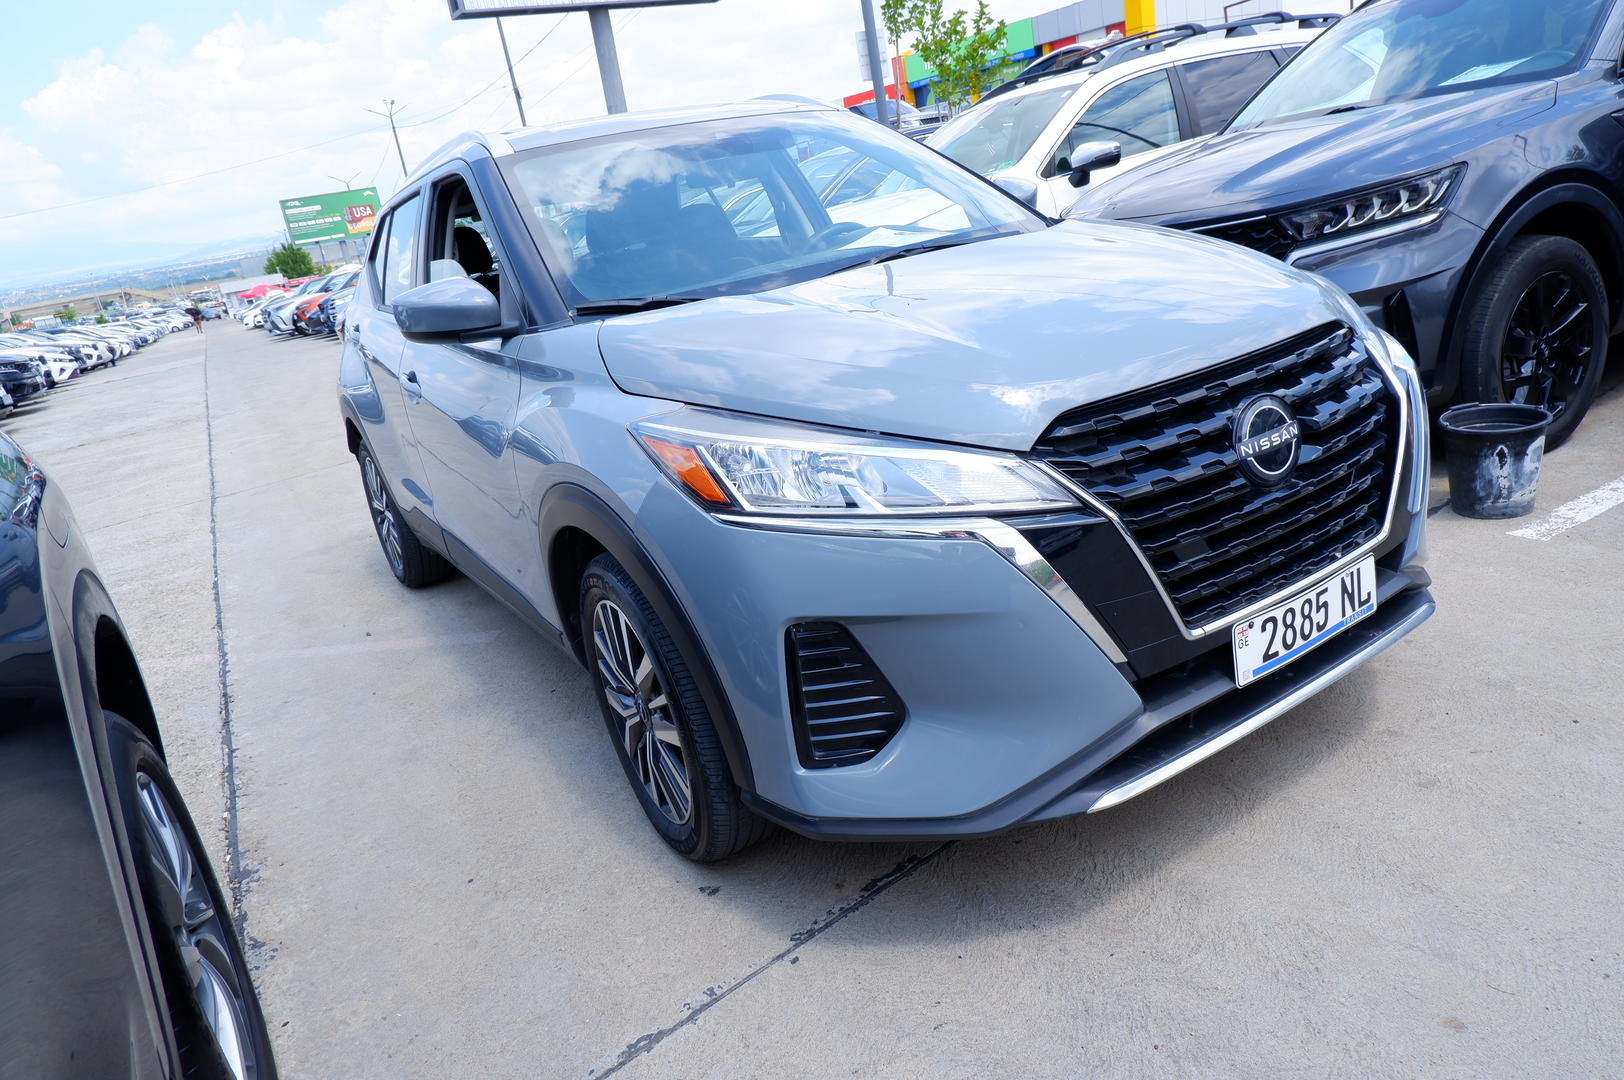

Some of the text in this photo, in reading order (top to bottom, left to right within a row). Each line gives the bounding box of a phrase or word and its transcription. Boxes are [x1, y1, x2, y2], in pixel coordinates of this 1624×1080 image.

[352, 206, 373, 218] USA
[1240, 423, 1298, 456] NISSAN
[1260, 567, 1372, 663] 2885 NL
[1343, 607, 1367, 625] TRANSIT
[1238, 636, 1249, 650] GE
